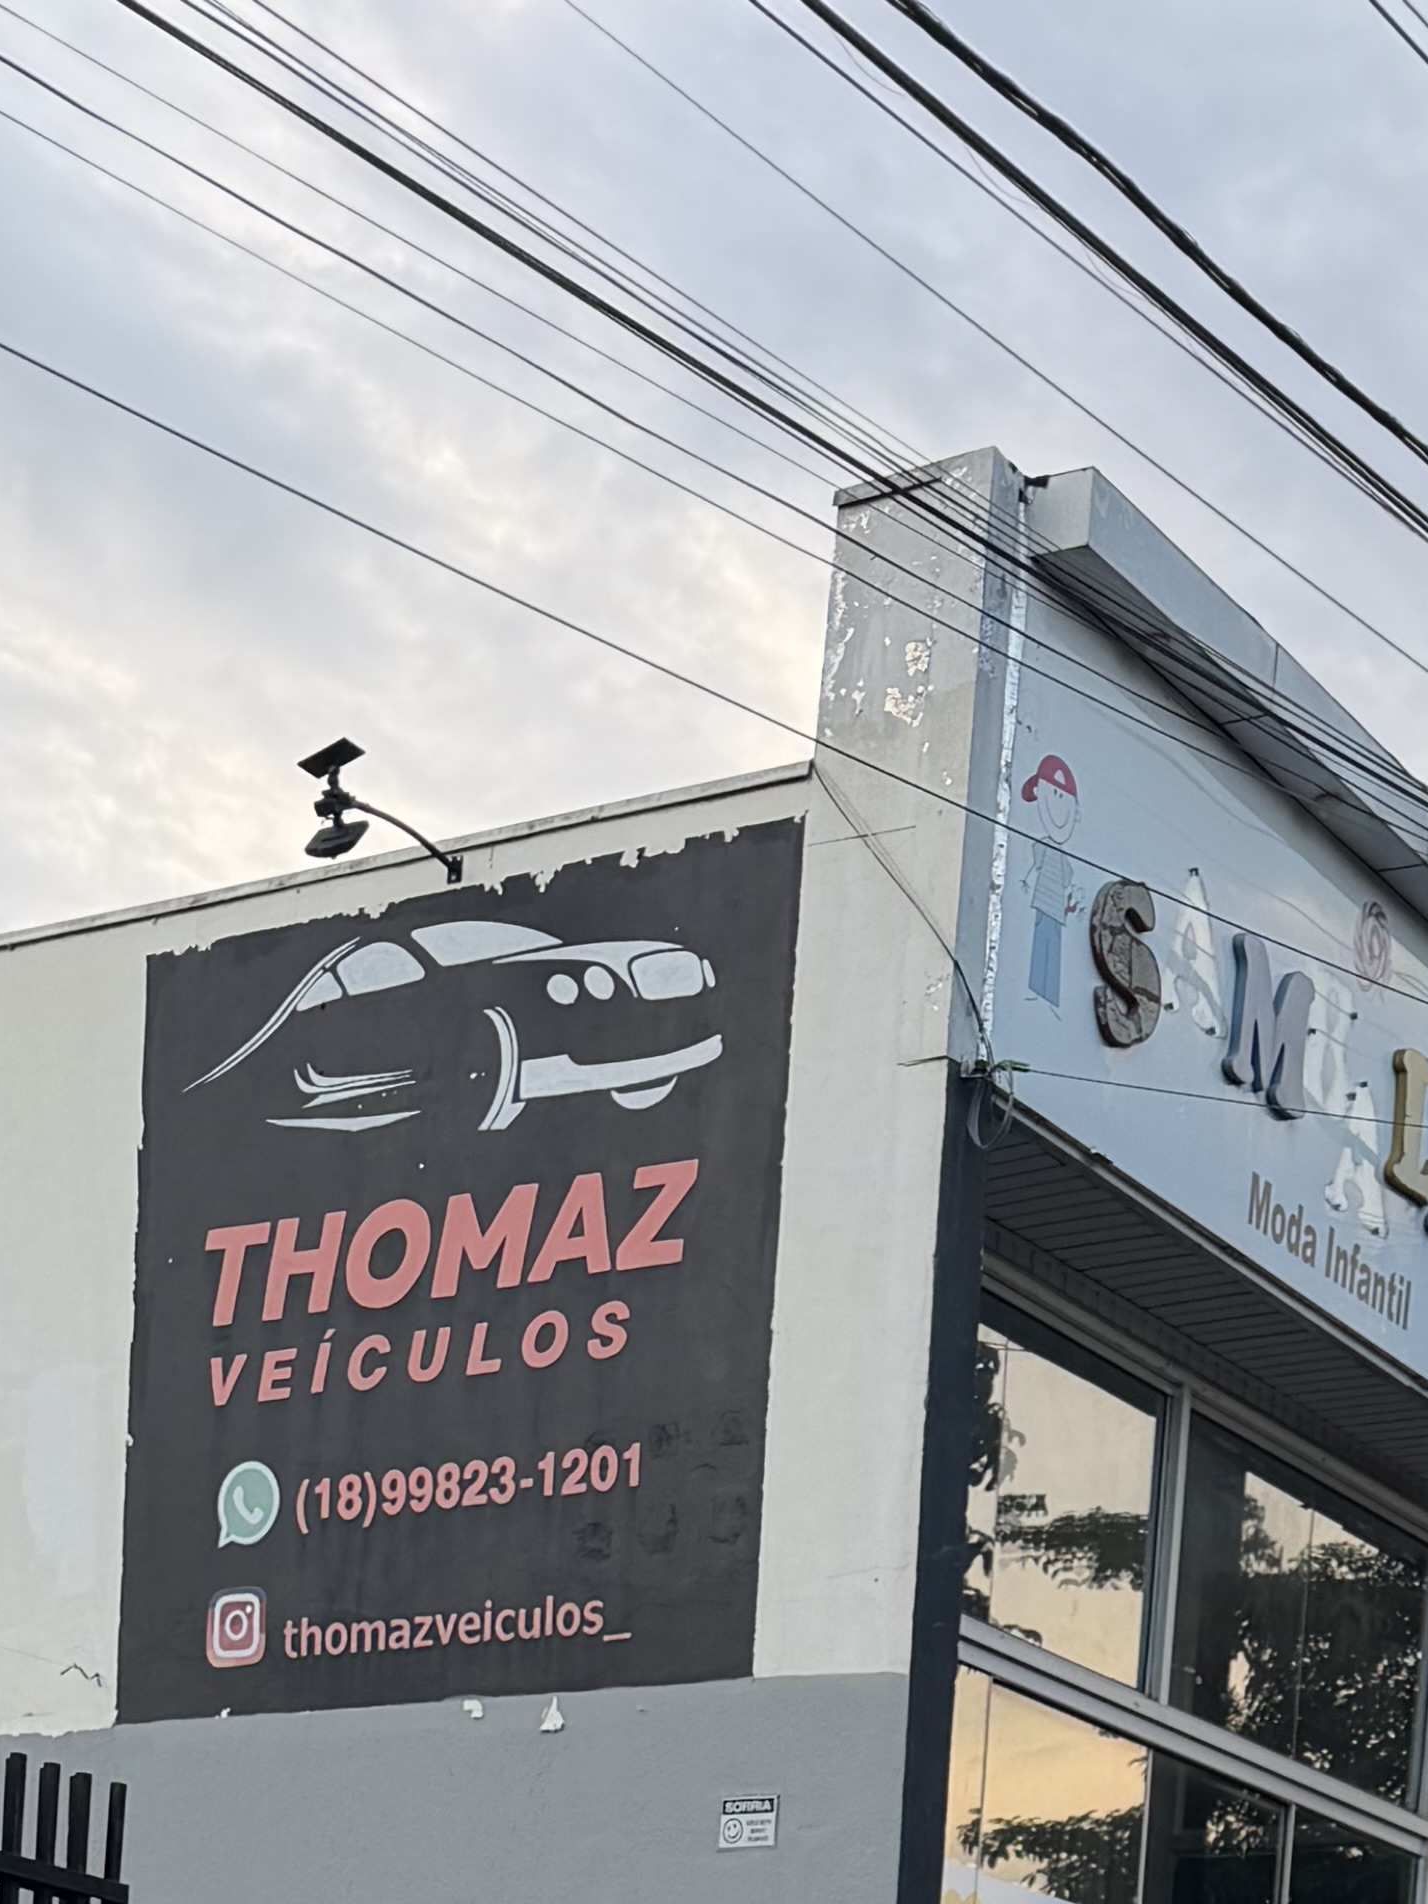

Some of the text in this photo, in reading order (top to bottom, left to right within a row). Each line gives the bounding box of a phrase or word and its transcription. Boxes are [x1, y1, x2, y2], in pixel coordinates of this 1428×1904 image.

[204, 1158, 699, 1328] THOMAZ
[1247, 1171, 1412, 1331] Moda Infantil
[209, 1300, 631, 1407] VEÍCULOS
[295, 1442, 643, 1535] (18)99823-1201
[283, 1594, 632, 1660] thomazveiculos_
